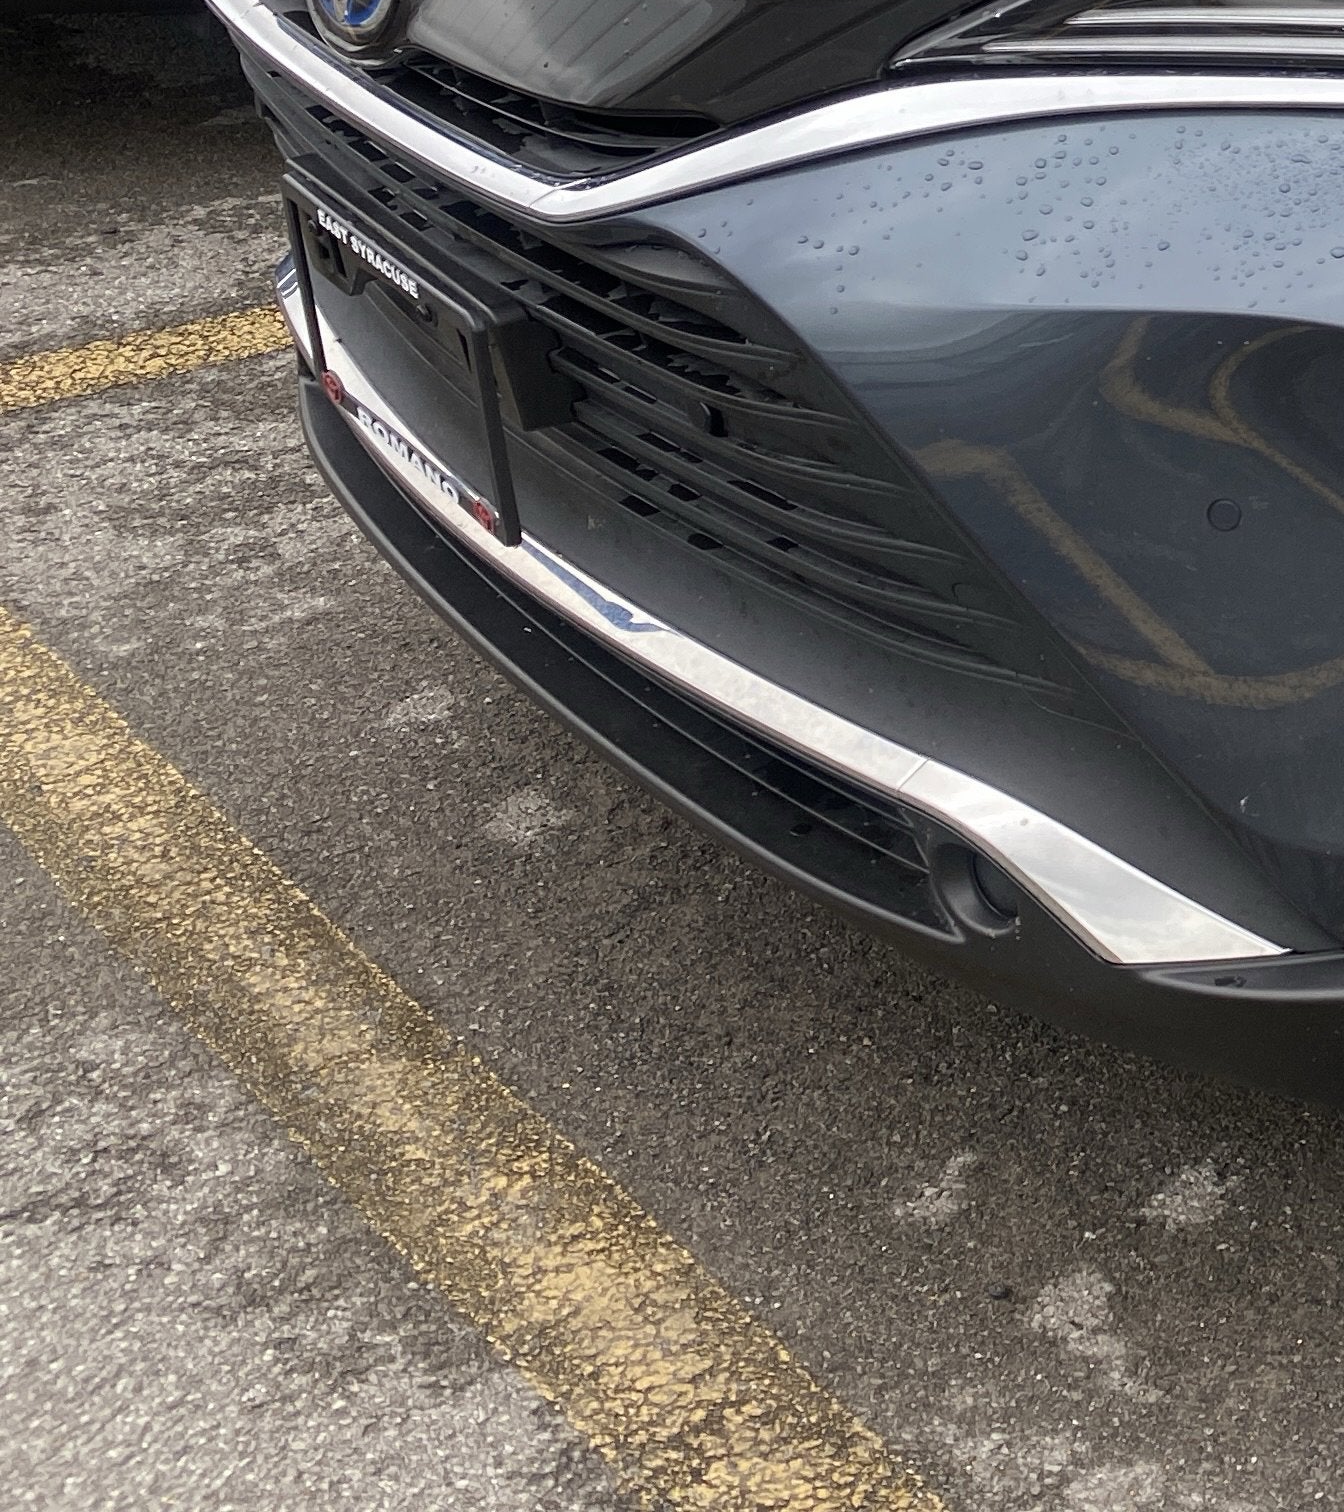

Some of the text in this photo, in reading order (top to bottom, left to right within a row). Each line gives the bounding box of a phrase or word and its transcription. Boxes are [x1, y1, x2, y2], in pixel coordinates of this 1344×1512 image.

[317, 208, 419, 300] EAST SYRACUSE
[356, 405, 460, 505] ROMANO
